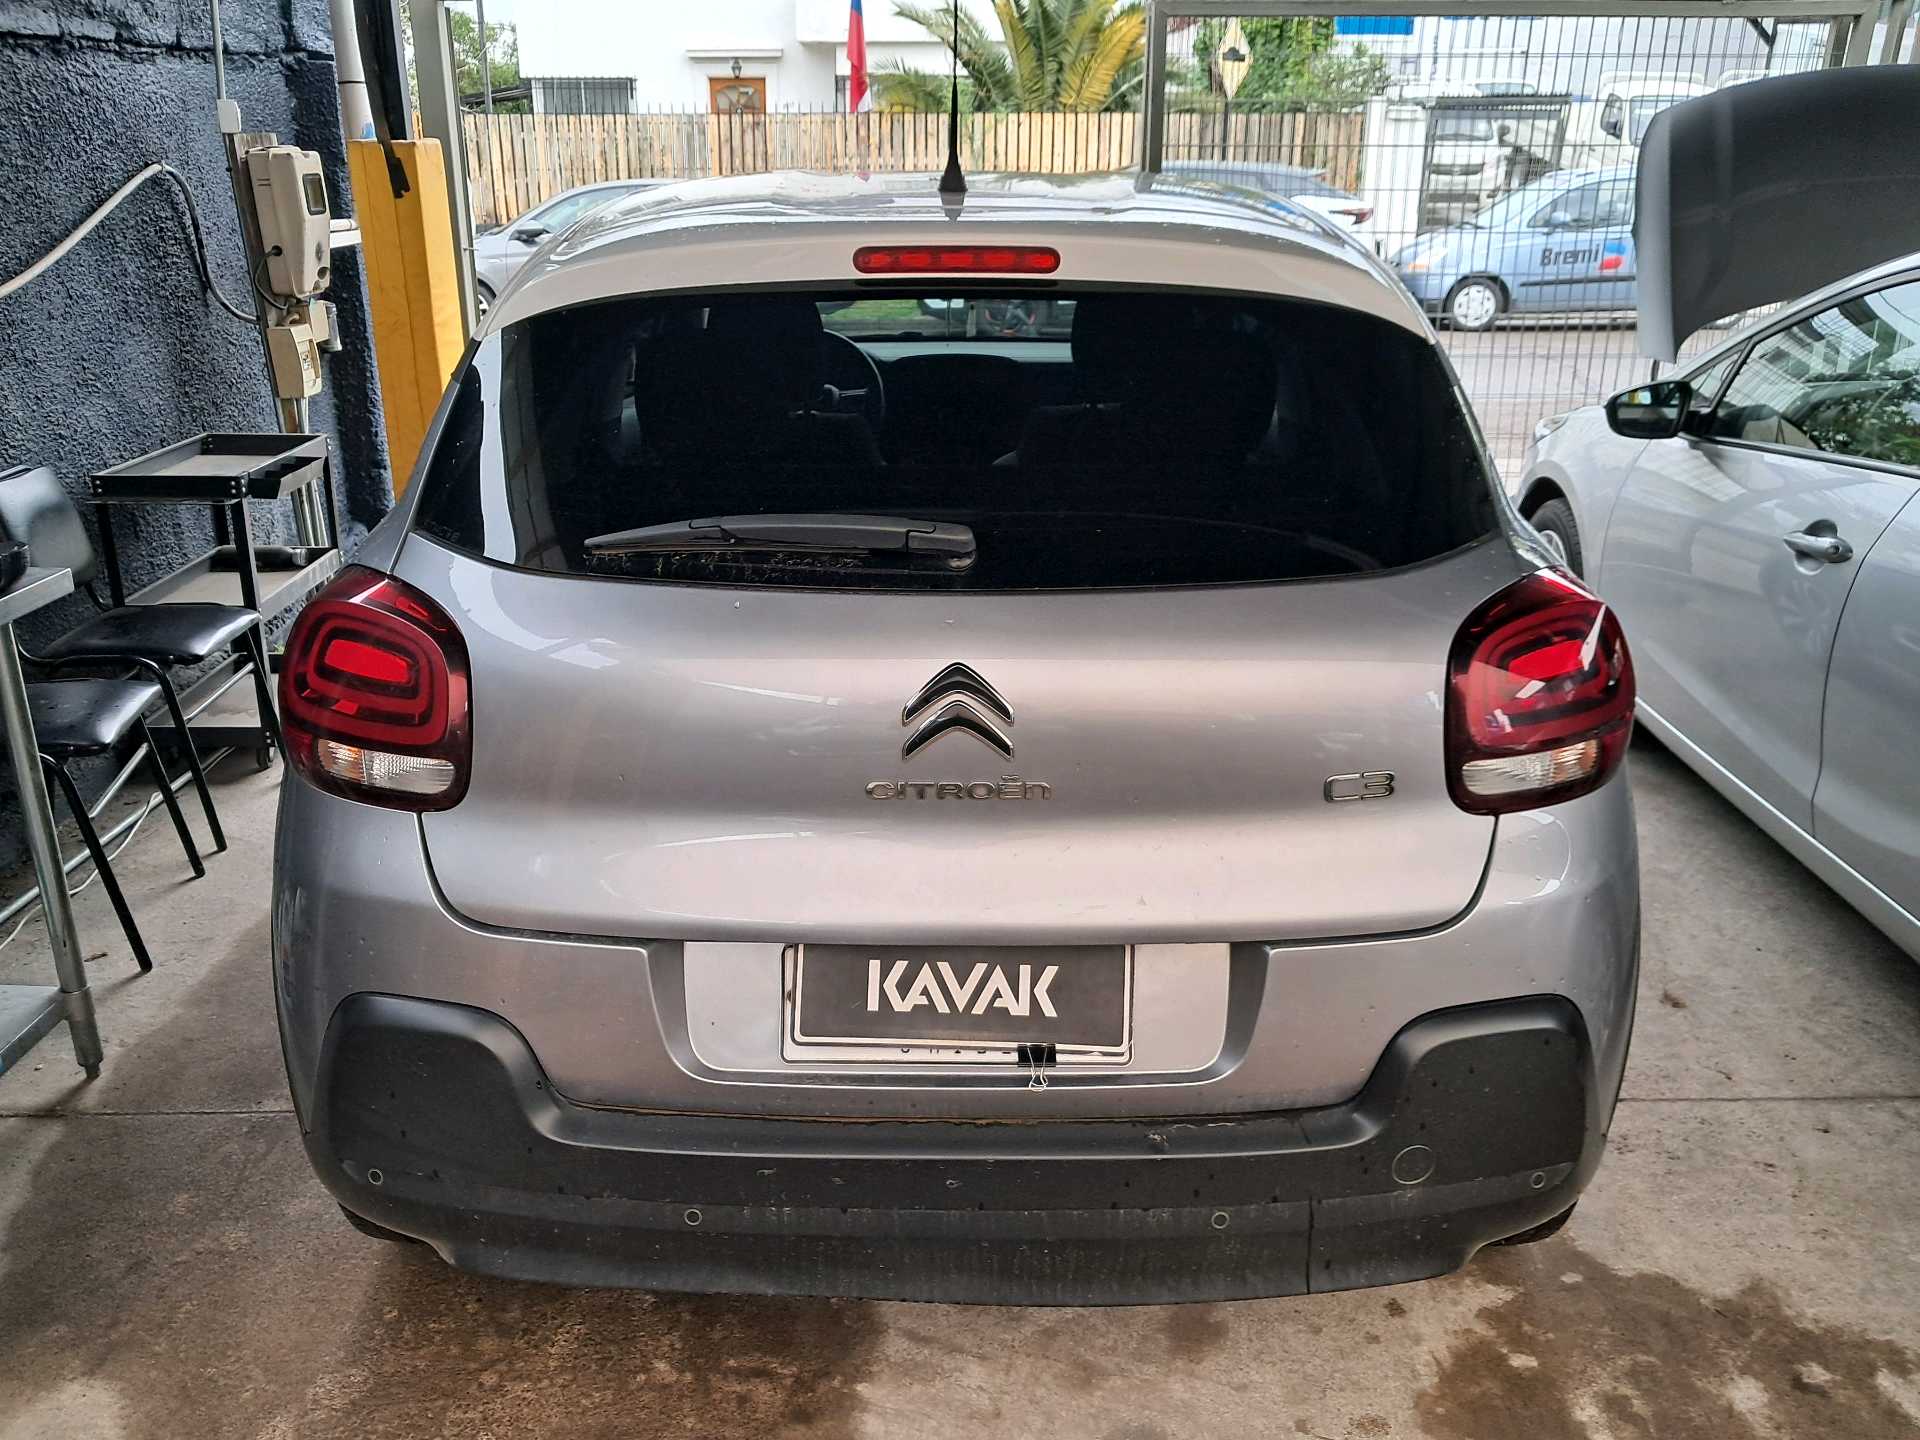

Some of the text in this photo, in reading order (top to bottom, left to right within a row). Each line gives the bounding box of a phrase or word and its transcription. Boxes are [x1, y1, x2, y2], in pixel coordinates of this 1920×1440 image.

[1541, 244, 1600, 266] Bremi
[1323, 770, 1395, 803] C3
[867, 959, 1059, 1017] KAVAK
